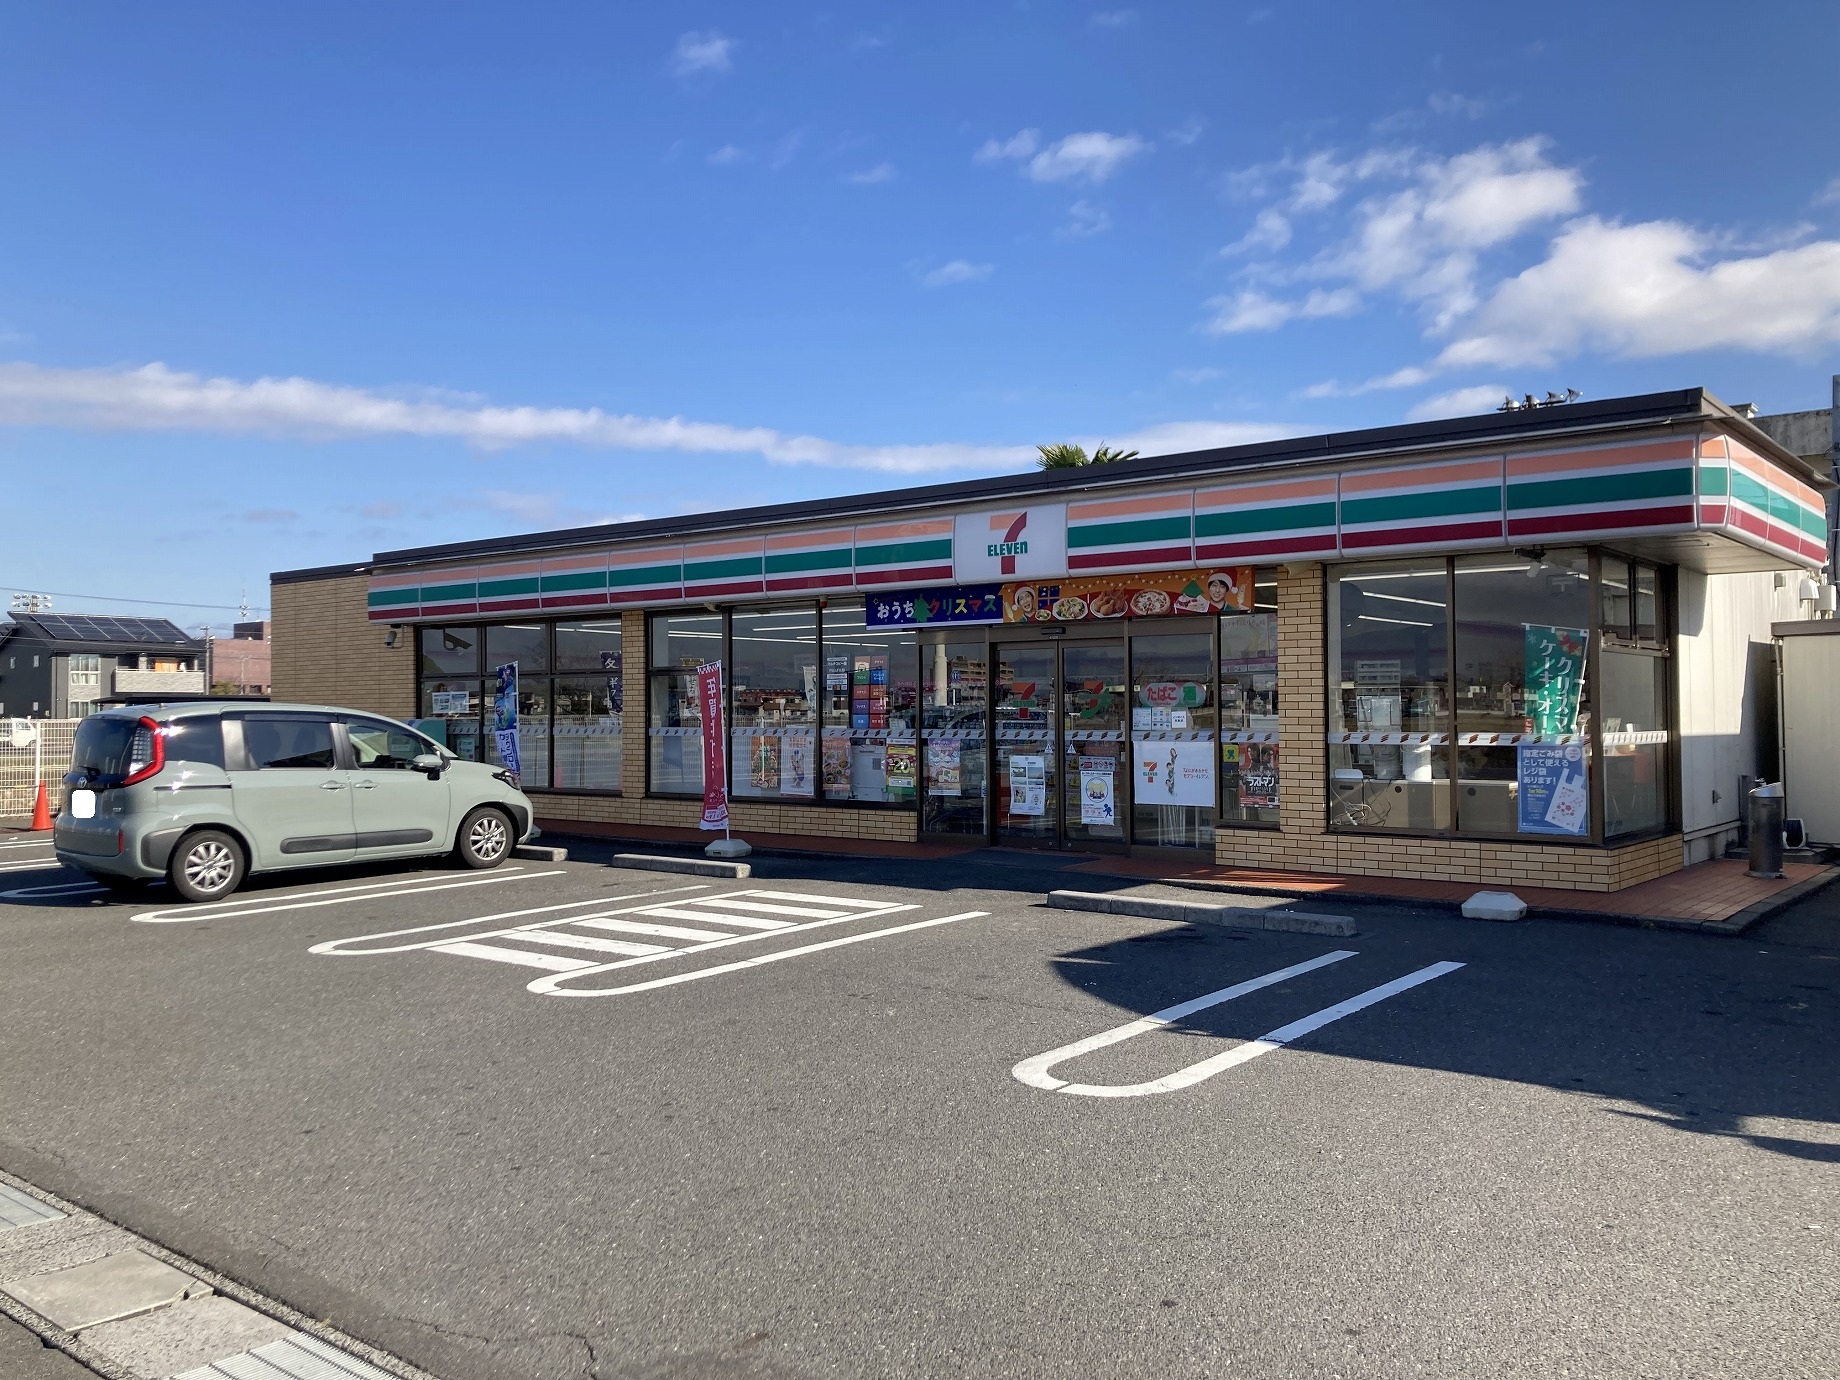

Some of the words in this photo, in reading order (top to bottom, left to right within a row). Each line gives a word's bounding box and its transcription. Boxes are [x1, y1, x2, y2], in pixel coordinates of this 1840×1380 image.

[989, 511, 1028, 574] 7
[877, 601, 914, 619] おうち
[930, 595, 996, 616] クリスマス
[1147, 687, 1177, 702] たばこ
[1554, 656, 1572, 733] クリスマ
[1523, 750, 1563, 758] 指定ごみ袋
[1523, 758, 1569, 767] として使える
